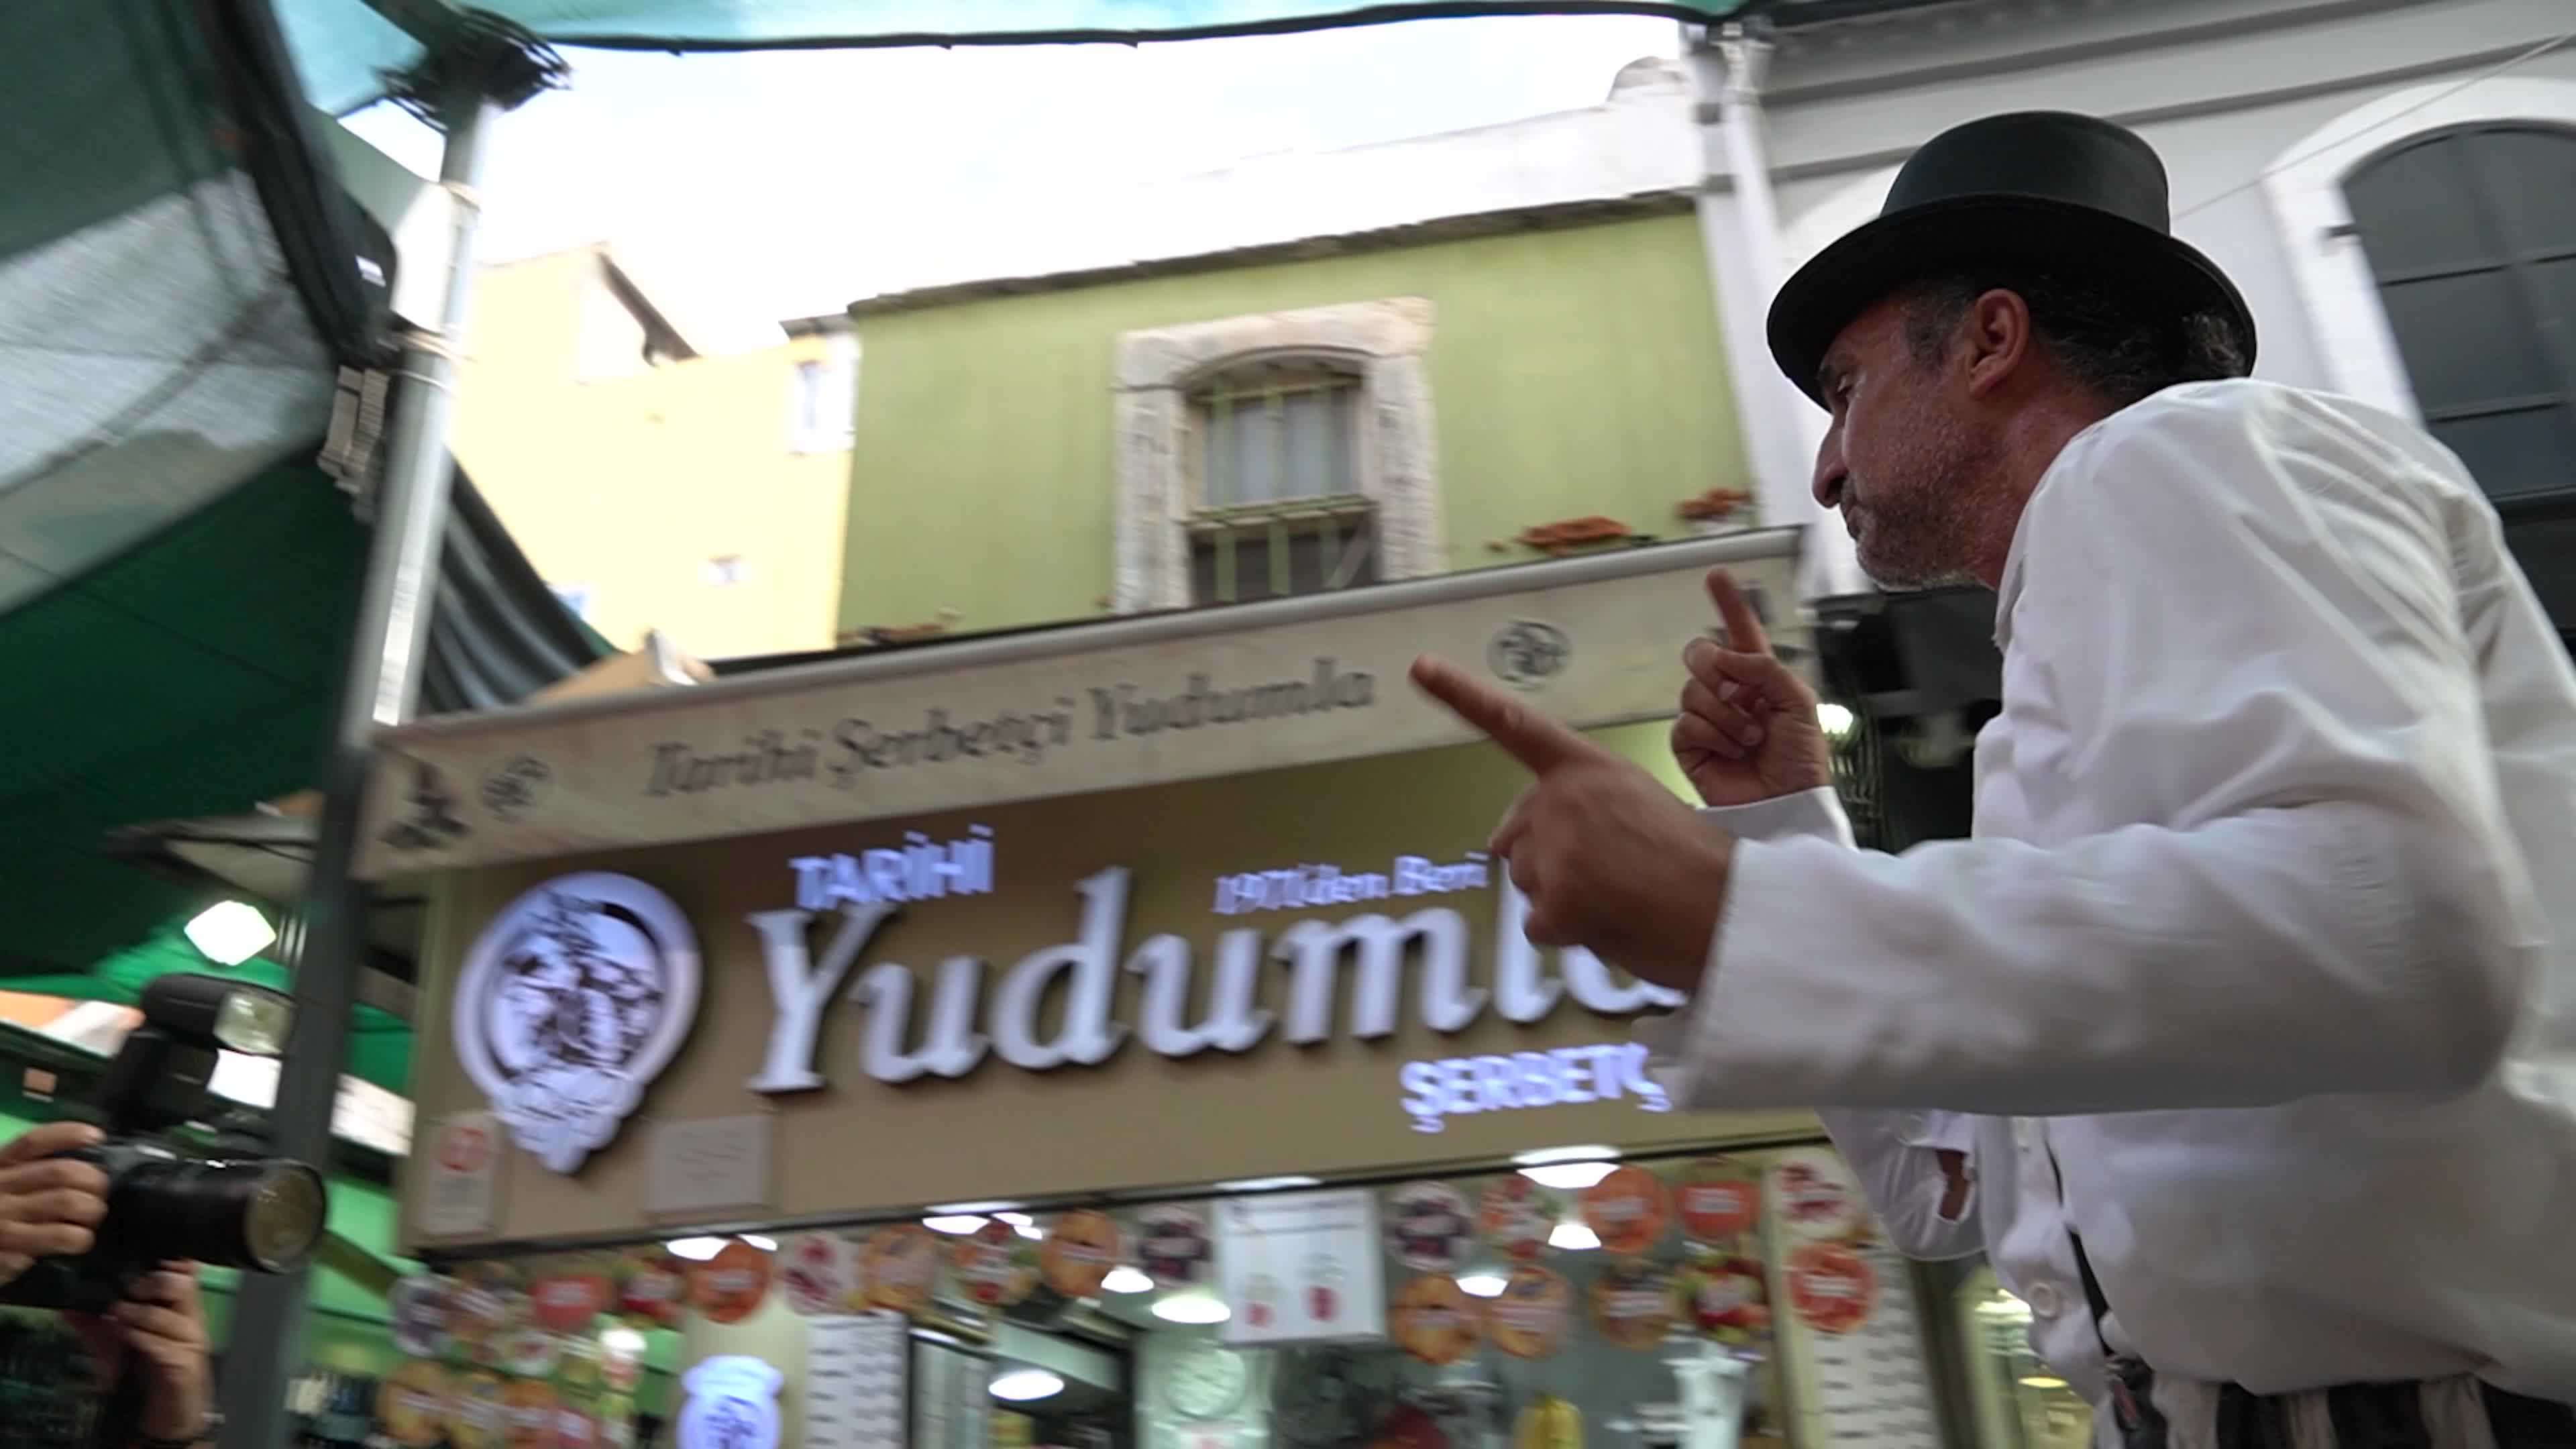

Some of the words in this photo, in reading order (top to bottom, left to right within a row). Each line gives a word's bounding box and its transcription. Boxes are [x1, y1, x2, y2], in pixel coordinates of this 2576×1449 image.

[647, 727, 824, 797] Tarihi
[1086, 656, 1375, 741] Yudumla
[1392, 850, 1489, 896] Beri
